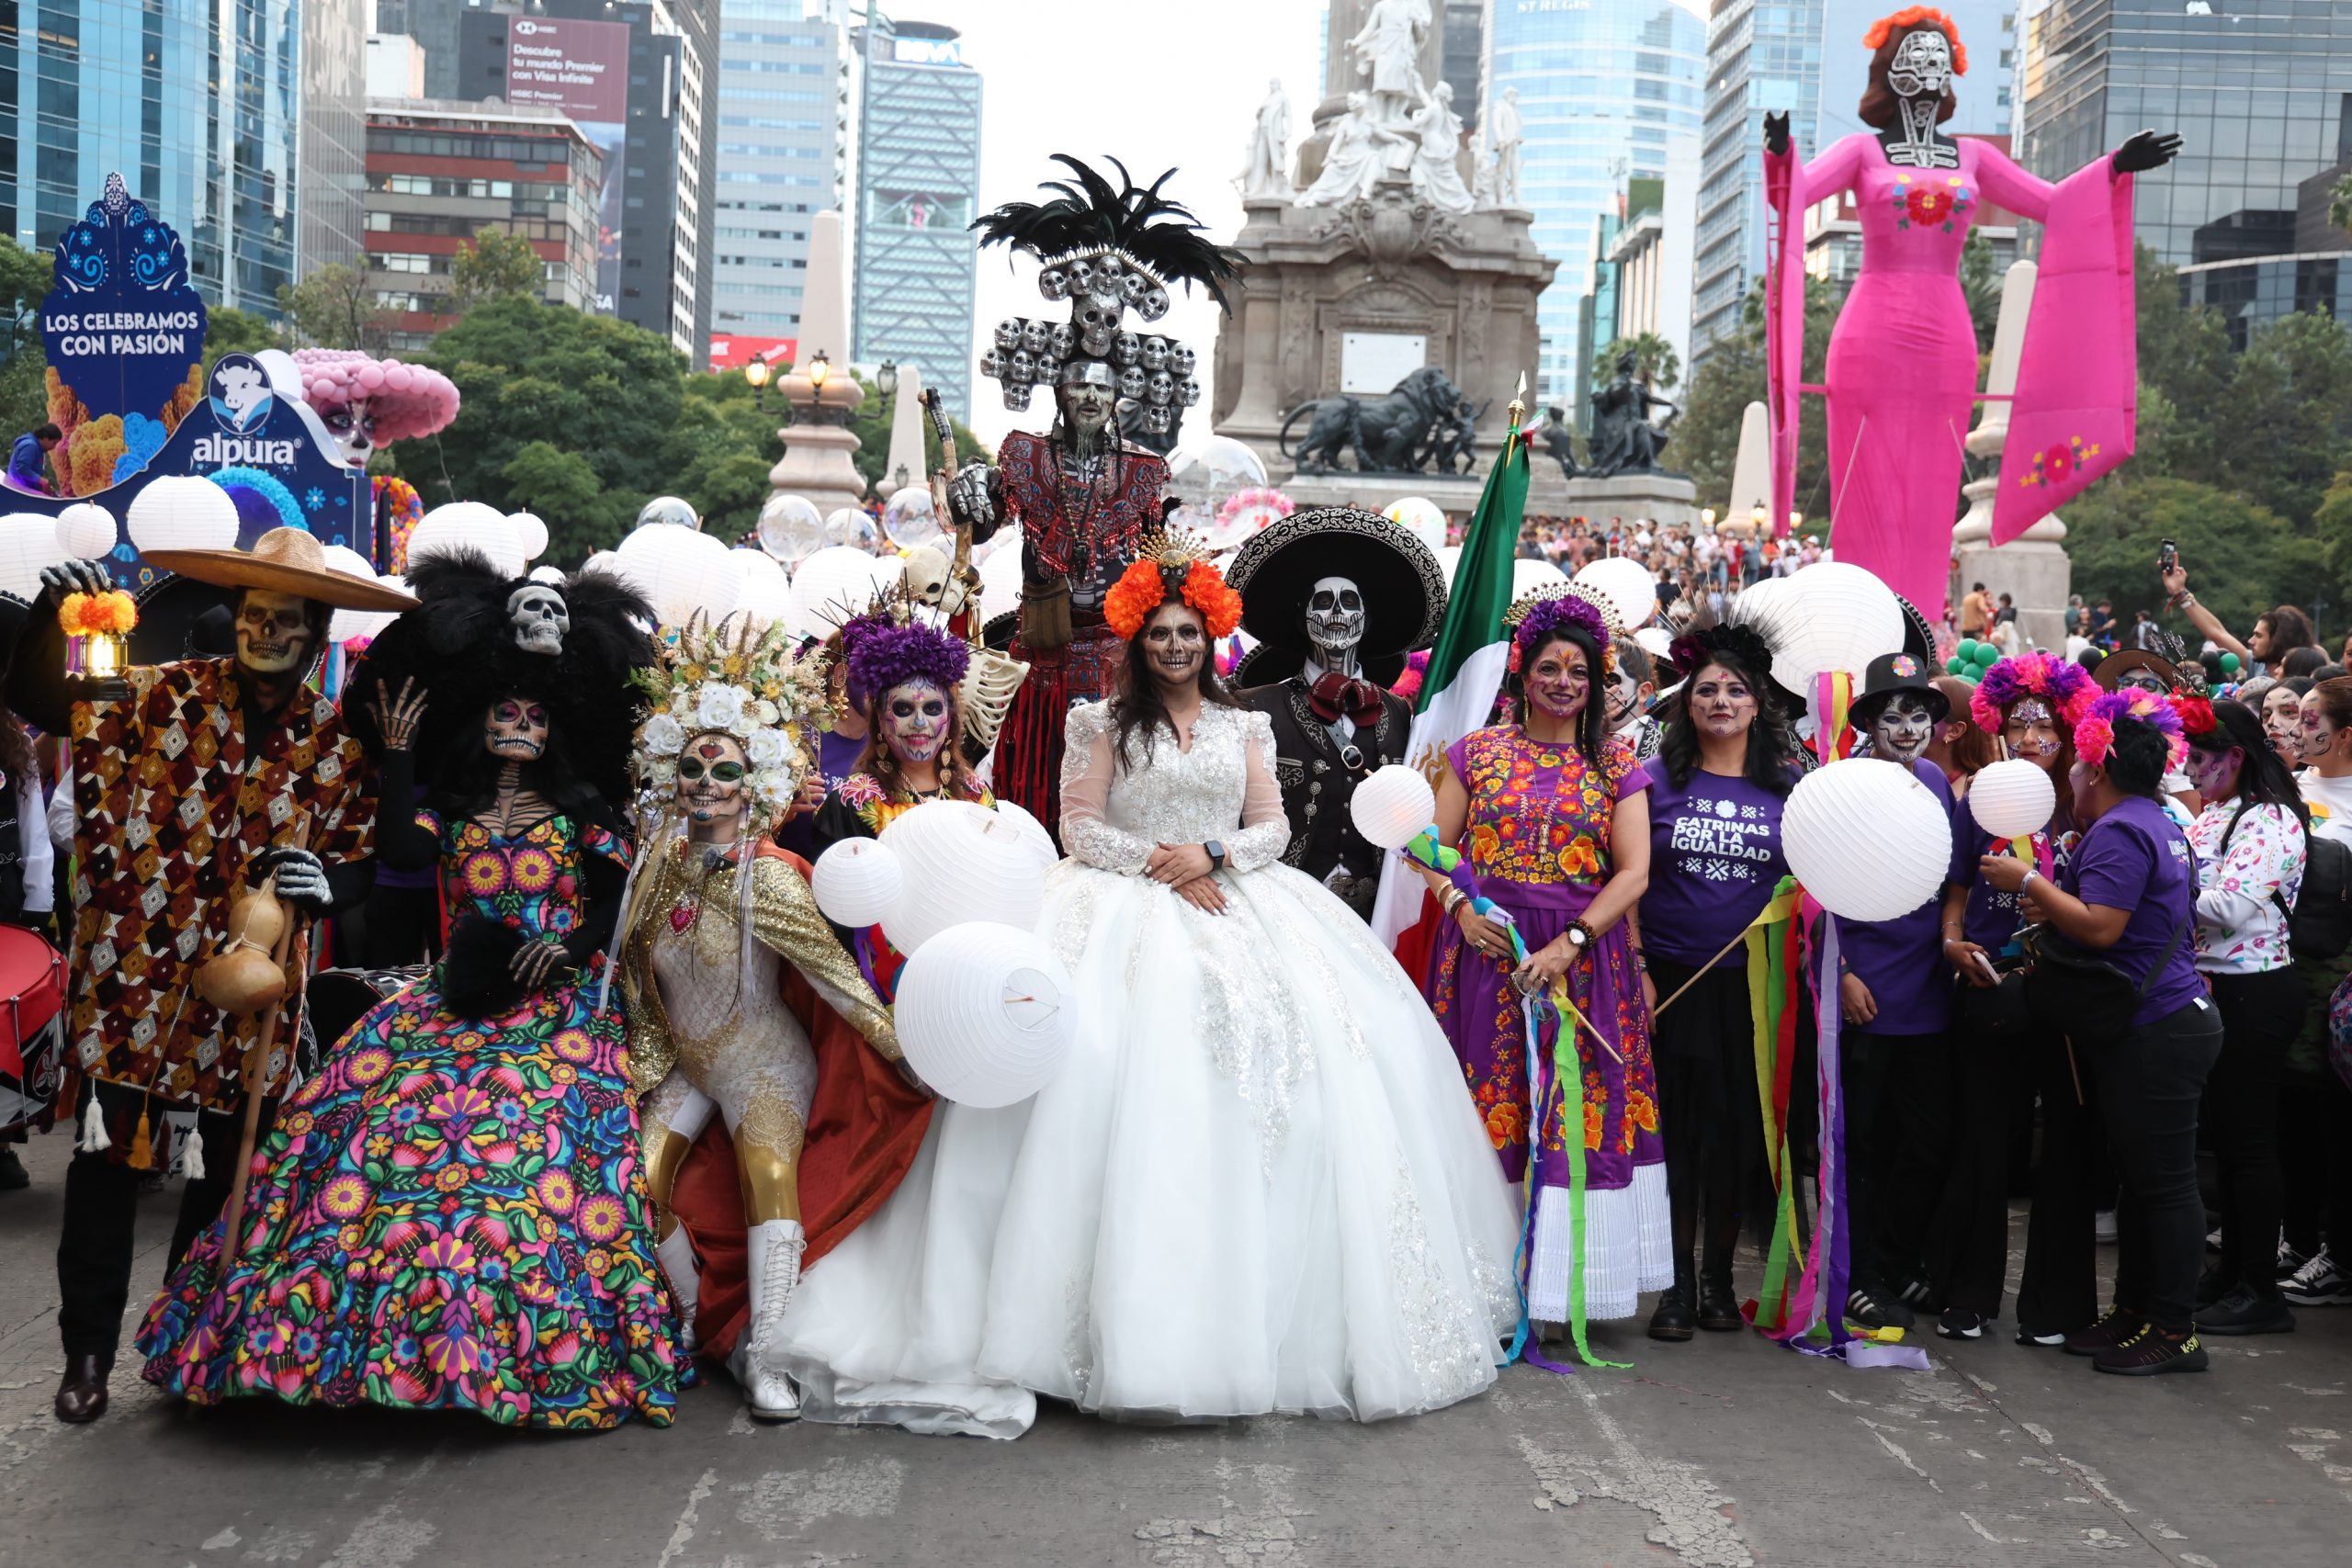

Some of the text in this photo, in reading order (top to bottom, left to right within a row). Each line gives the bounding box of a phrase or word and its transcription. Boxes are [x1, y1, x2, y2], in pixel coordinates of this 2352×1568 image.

[514, 44, 562, 57] Descubre
[513, 58, 605, 73] tu mundo Premier
[513, 71, 594, 85] con Visa Infinite
[46, 312, 198, 332] LOS CELEBRAMOS
[61, 329, 185, 355] CON PASIÓN
[1674, 824, 1744, 845] POR LA
[1676, 817, 1770, 837] CATRINAS
[1671, 836, 1771, 862] IGUALDAD
